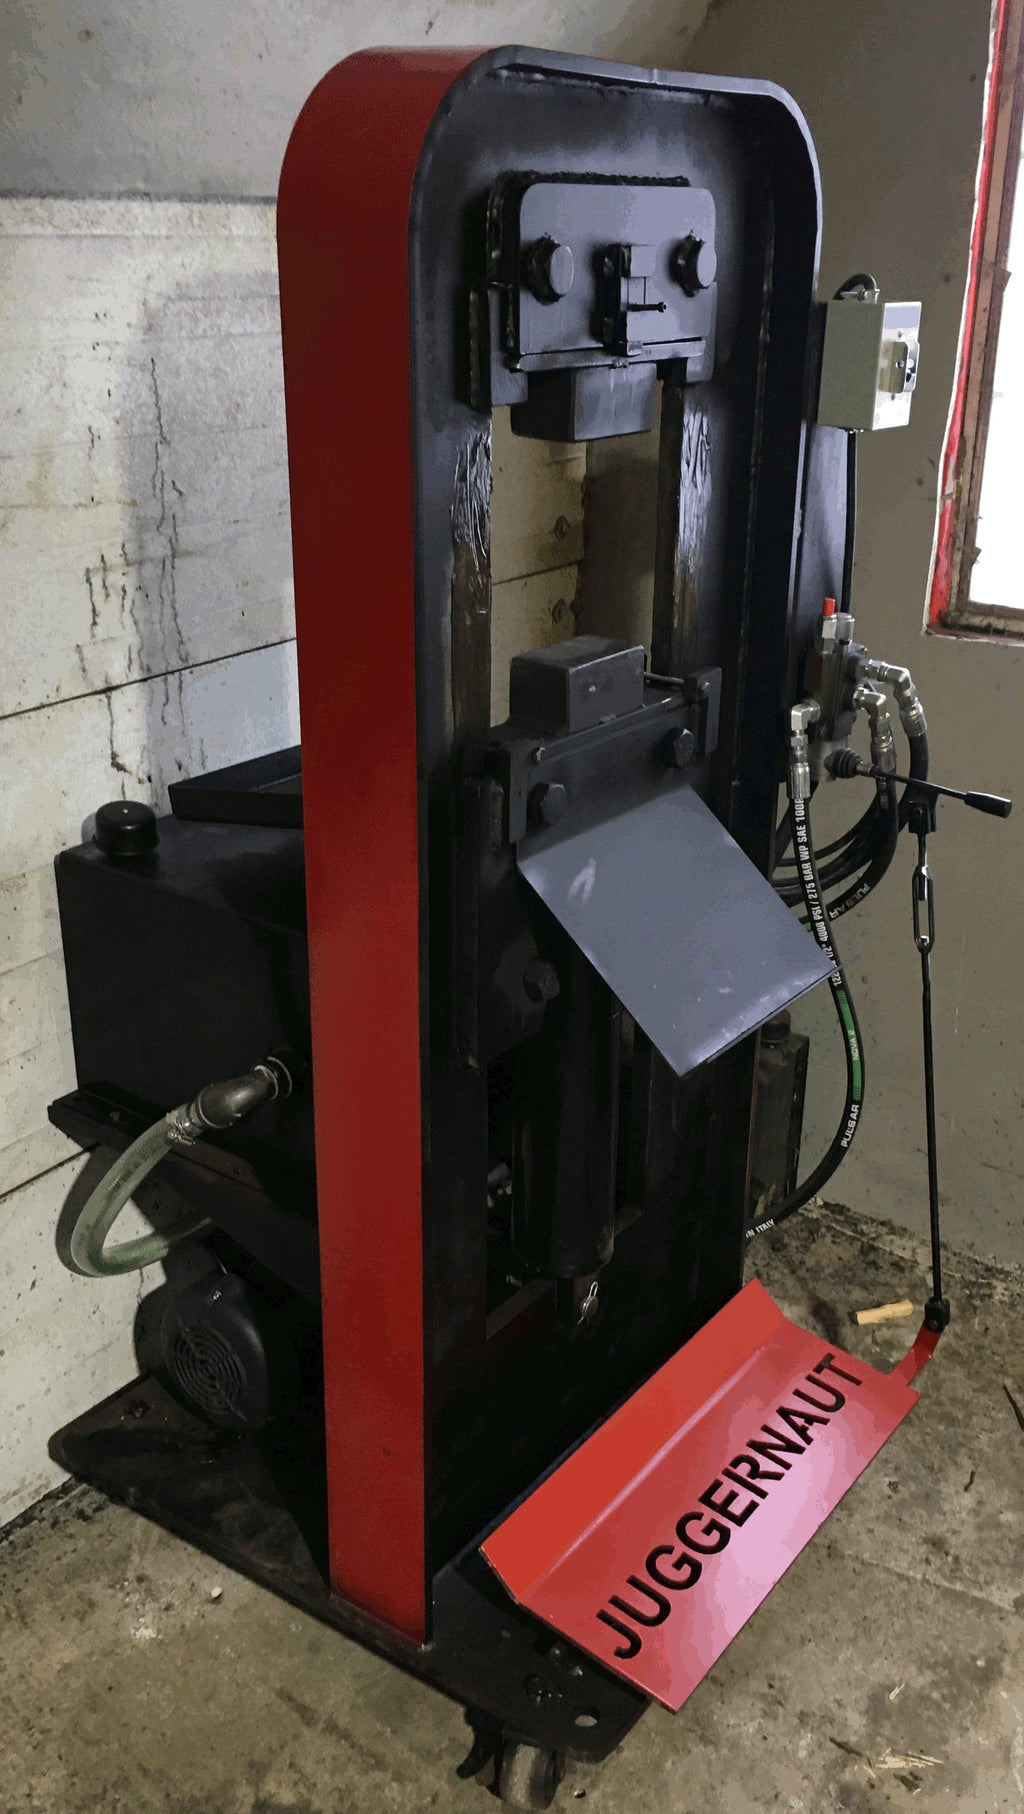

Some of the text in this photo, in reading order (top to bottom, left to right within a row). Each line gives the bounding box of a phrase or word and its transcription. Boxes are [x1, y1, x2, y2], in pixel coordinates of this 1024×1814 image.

[797, 824, 808, 844] SAE
[799, 845, 811, 861] WP
[802, 862, 815, 882] BAR
[806, 883, 818, 900] 275
[829, 882, 871, 919] PULSAR
[812, 904, 823, 922] PSI
[815, 921, 829, 942] 4000
[840, 1104, 859, 1148] PULSAR
[755, 1218, 775, 1232] ITALY
[595, 1352, 863, 1660] JUGGERNAUT
